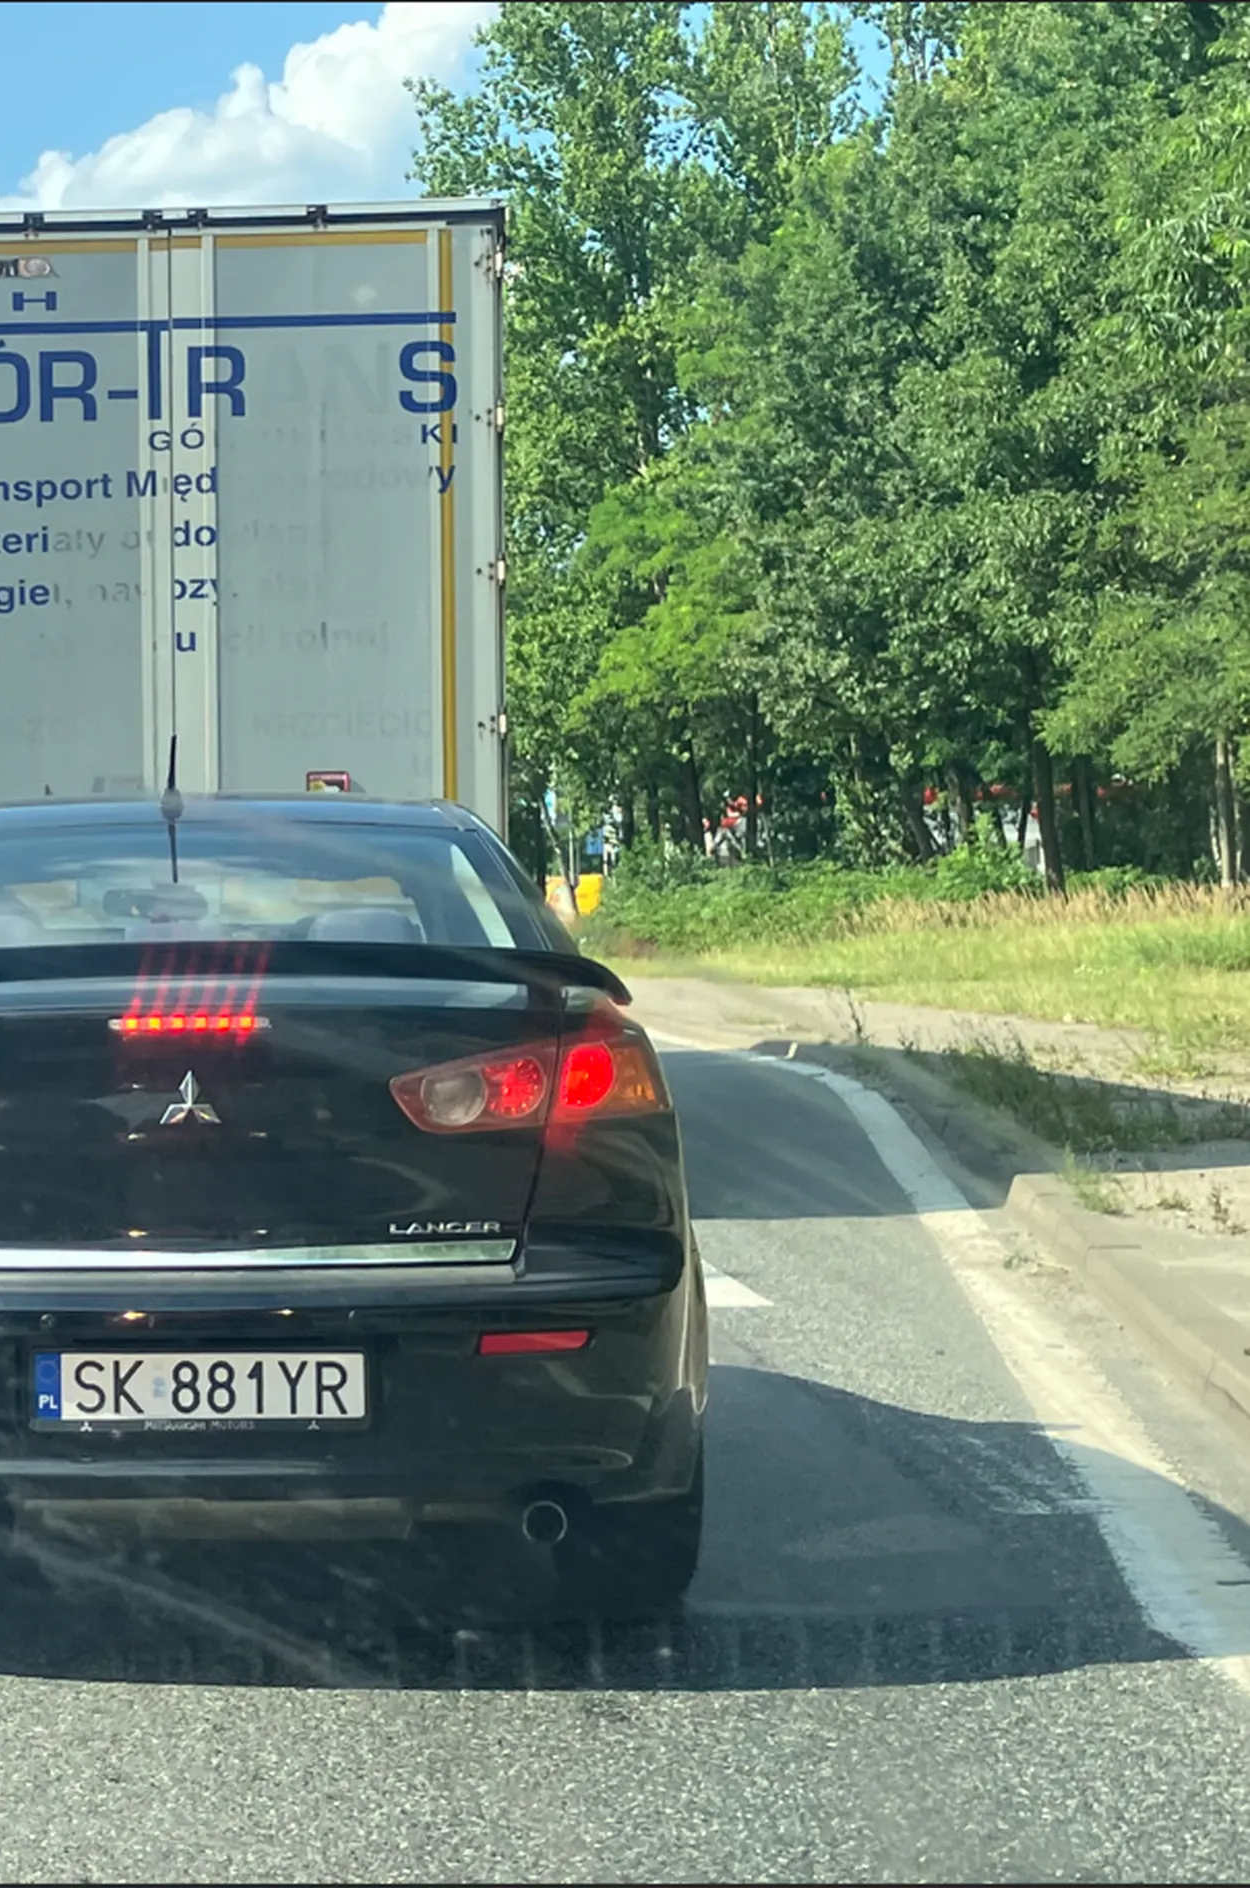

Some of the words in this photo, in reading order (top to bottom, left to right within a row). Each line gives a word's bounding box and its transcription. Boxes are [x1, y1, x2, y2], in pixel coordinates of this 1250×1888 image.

[388, 1220, 502, 1235] LANCER
[74, 1359, 145, 1414] SK
[170, 1359, 349, 1415] 881YR
[38, 1394, 59, 1410] PL
